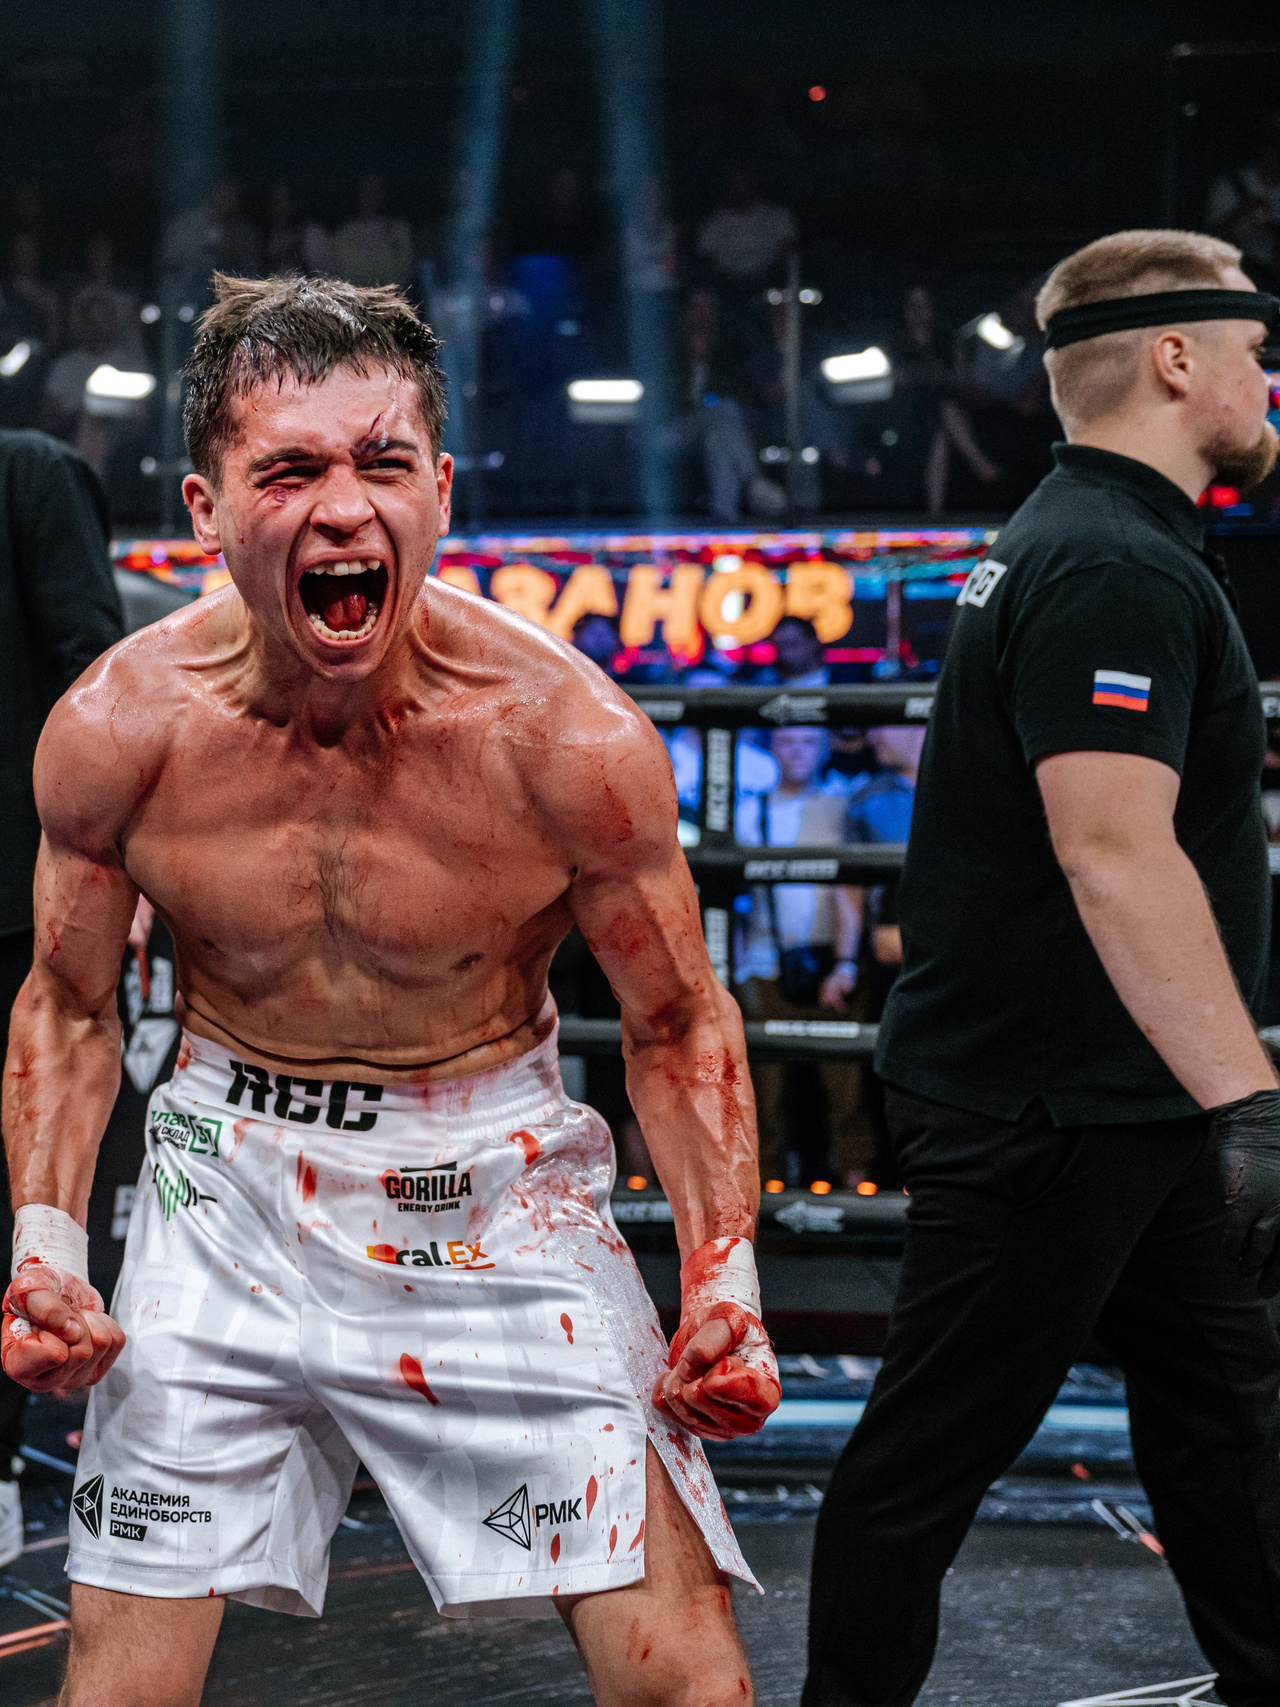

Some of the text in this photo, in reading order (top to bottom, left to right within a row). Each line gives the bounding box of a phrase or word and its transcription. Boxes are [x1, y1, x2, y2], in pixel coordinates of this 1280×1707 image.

[225, 1059, 384, 1132] RCC
[385, 1172, 472, 1202] GORILLA
[398, 1200, 461, 1213] ENERGY DRINK
[111, 1486, 190, 1507] АКАДЕМИЯ
[110, 1501, 212, 1523] ЕДИНОБОРСТВ
[535, 1498, 582, 1528] РМК
[111, 1521, 143, 1540] РМК
